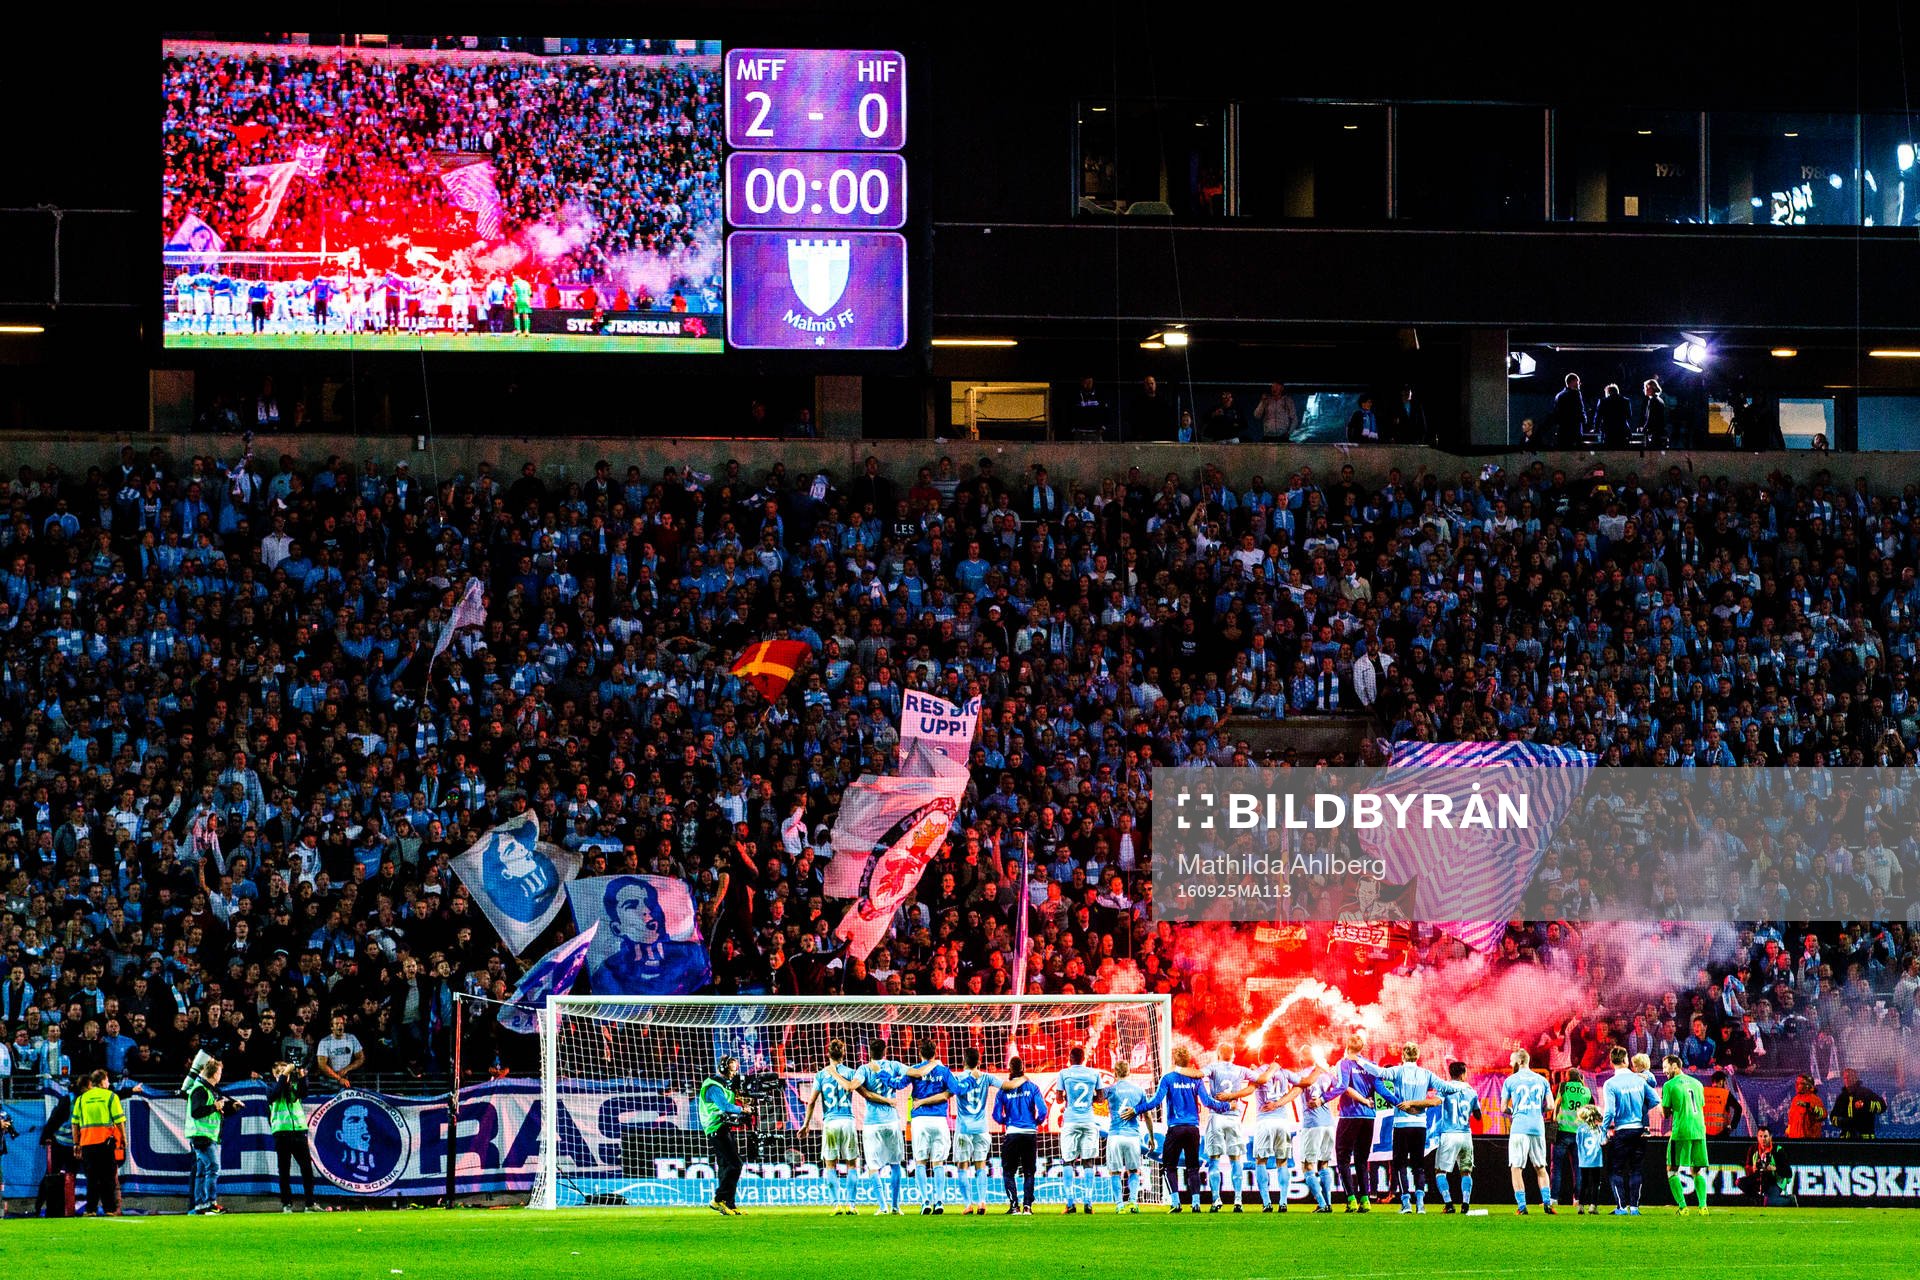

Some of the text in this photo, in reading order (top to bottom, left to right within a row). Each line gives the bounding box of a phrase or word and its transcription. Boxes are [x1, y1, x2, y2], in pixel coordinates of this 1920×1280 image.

[736, 58, 787, 81] MFF
[858, 60, 898, 82] HIF
[744, 91, 774, 138] 2
[858, 92, 888, 139] 0
[745, 167, 889, 215] 00:00
[783, 308, 855, 332] Malmö FF
[893, 523, 915, 535] LES
[905, 693, 945, 716] RES
[920, 717, 967, 737] UPP!
[1073, 1083, 1089, 1108] 2
[1516, 1084, 1544, 1111] 23
[1565, 1086, 1586, 1095] FOTO
[1688, 1088, 1697, 1113] 1
[700, 1182, 758, 1201] Hva
[767, 1181, 831, 1204] priset
